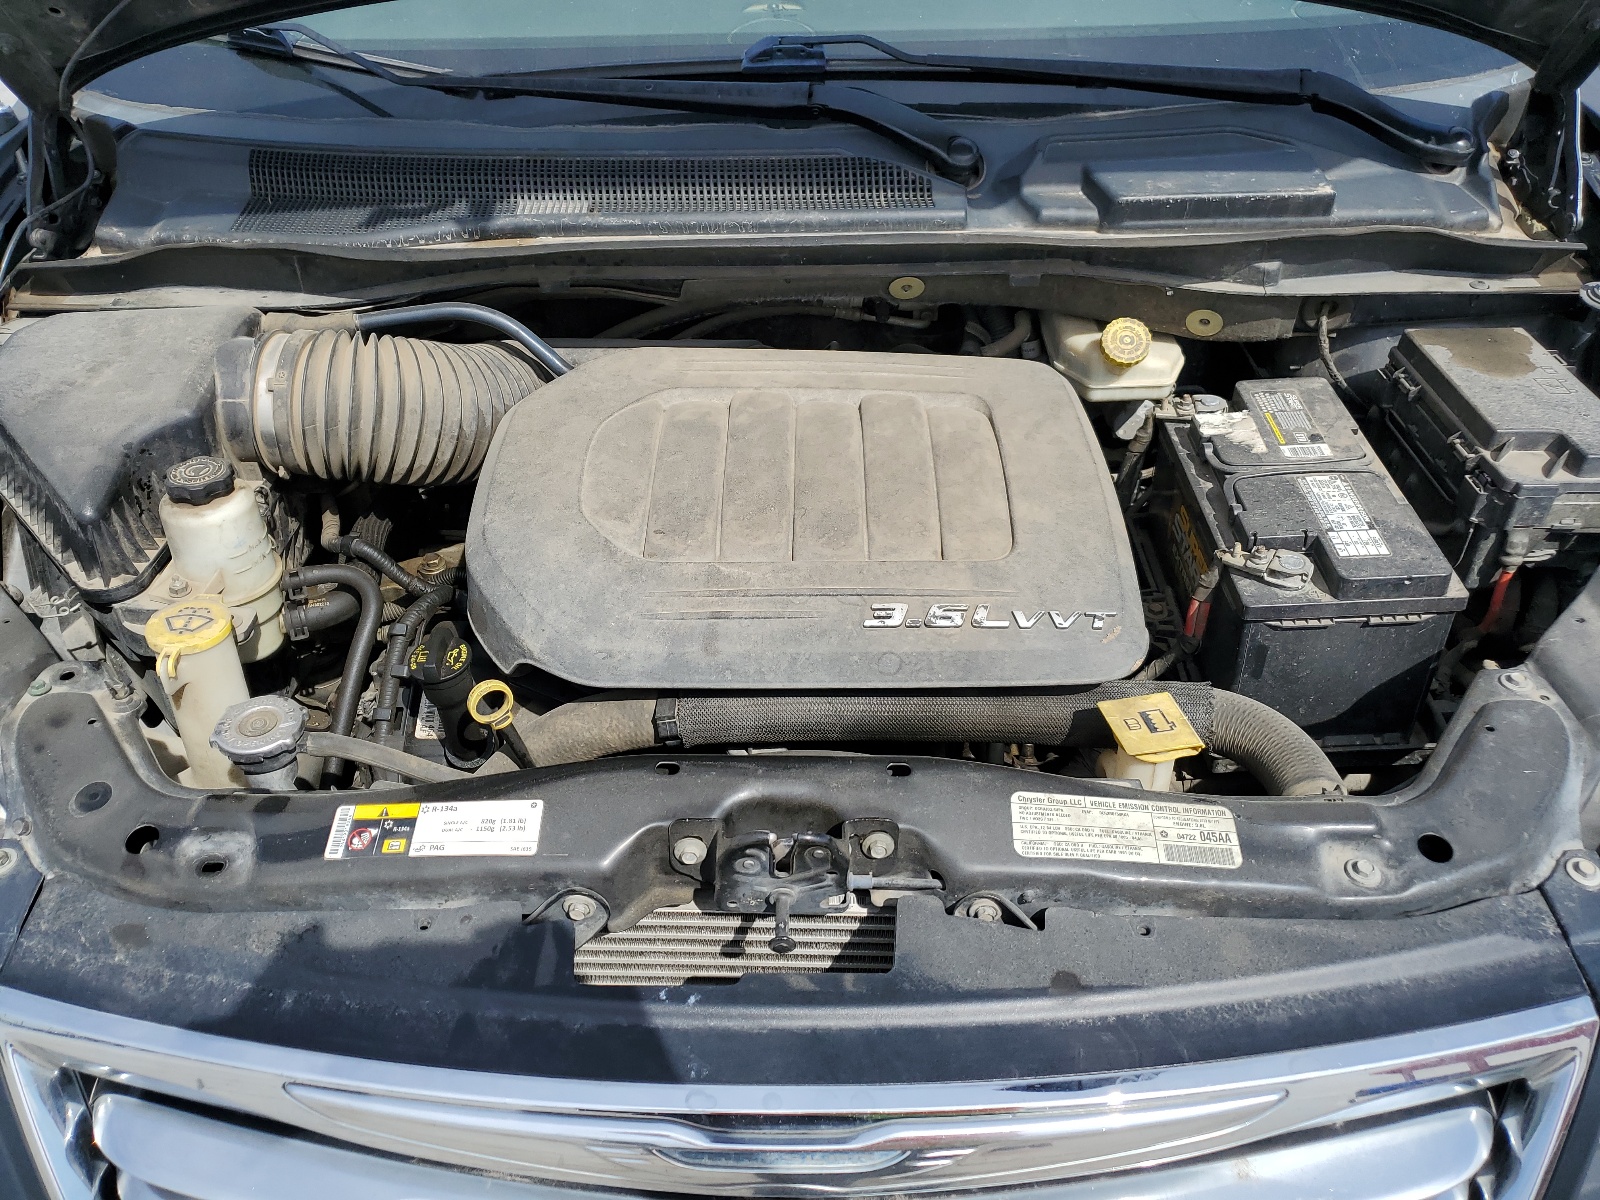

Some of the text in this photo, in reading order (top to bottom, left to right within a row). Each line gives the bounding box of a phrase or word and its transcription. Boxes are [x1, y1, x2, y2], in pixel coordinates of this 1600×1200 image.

[459, 644, 468, 662] ENGINE
[1017, 795, 1082, 806] Chrysler Group LLC
[431, 805, 458, 813] R-134a
[1089, 800, 1227, 817] VEHICLE EMISSION CONTROL INFORMATION
[1199, 831, 1232, 843] 045AA
